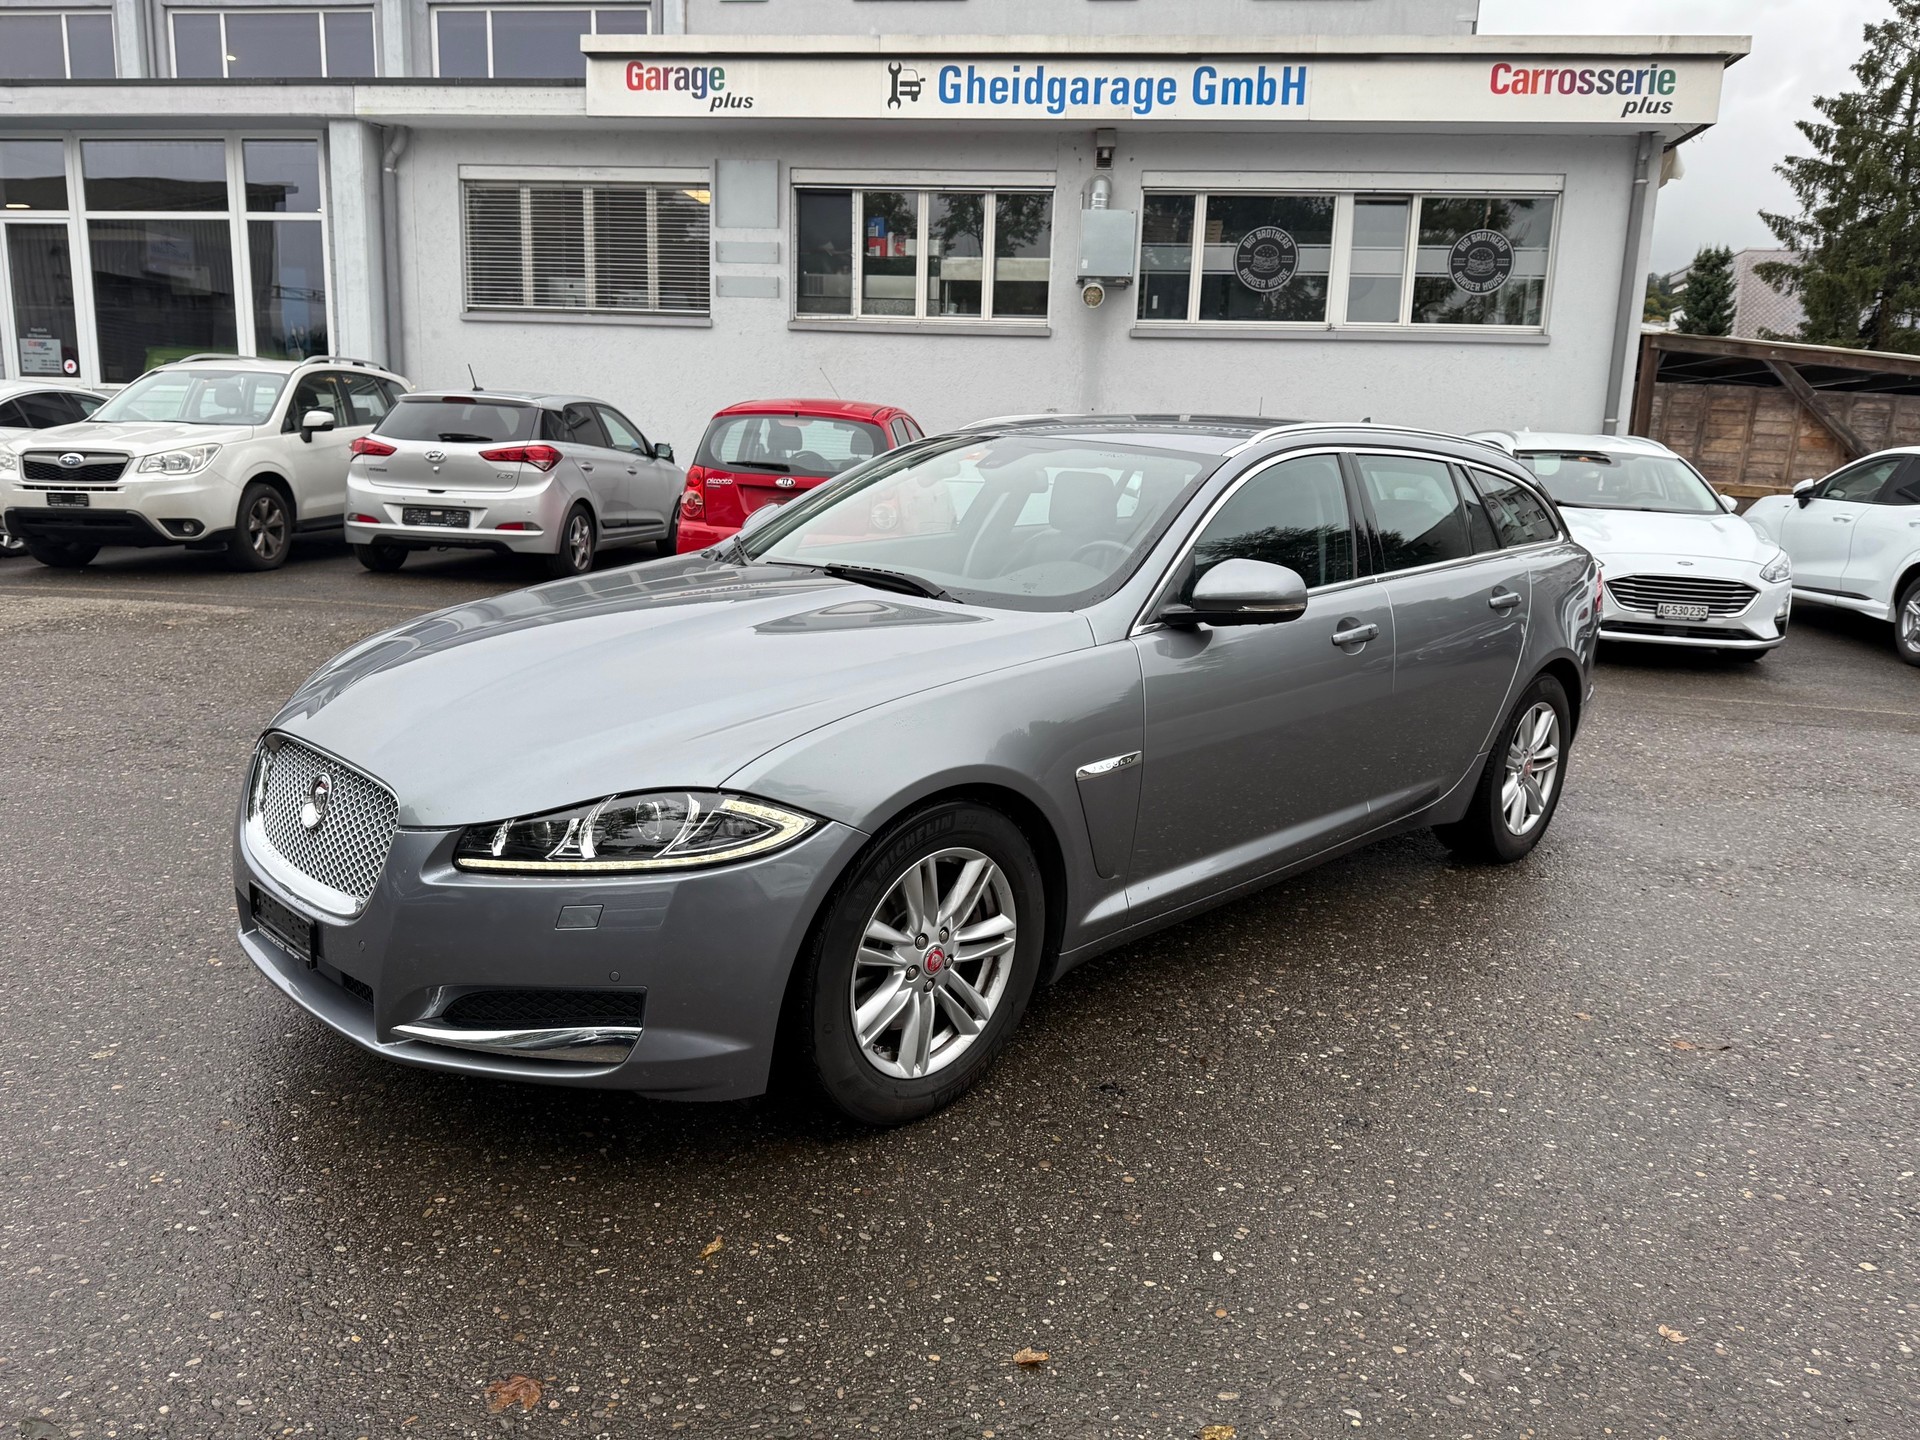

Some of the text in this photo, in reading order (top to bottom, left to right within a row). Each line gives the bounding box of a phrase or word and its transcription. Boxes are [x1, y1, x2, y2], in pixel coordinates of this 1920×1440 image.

[626, 61, 725, 99] Garage
[1490, 63, 1676, 95] Carrosserie
[938, 65, 1307, 114] Gheidgarage GmbH
[709, 92, 754, 112] plus
[1621, 97, 1673, 118] plus
[1243, 229, 1292, 249] BIG BROTHERS
[1457, 232, 1508, 252] BIG BROTHERS
[1240, 267, 1291, 288] BURGER HOUSE
[1454, 271, 1506, 291] BURGER HOUSE
[776, 478, 795, 487] KIA
[1092, 757, 1132, 772] JAGUAR
[875, 815, 952, 878] MICHELIN
